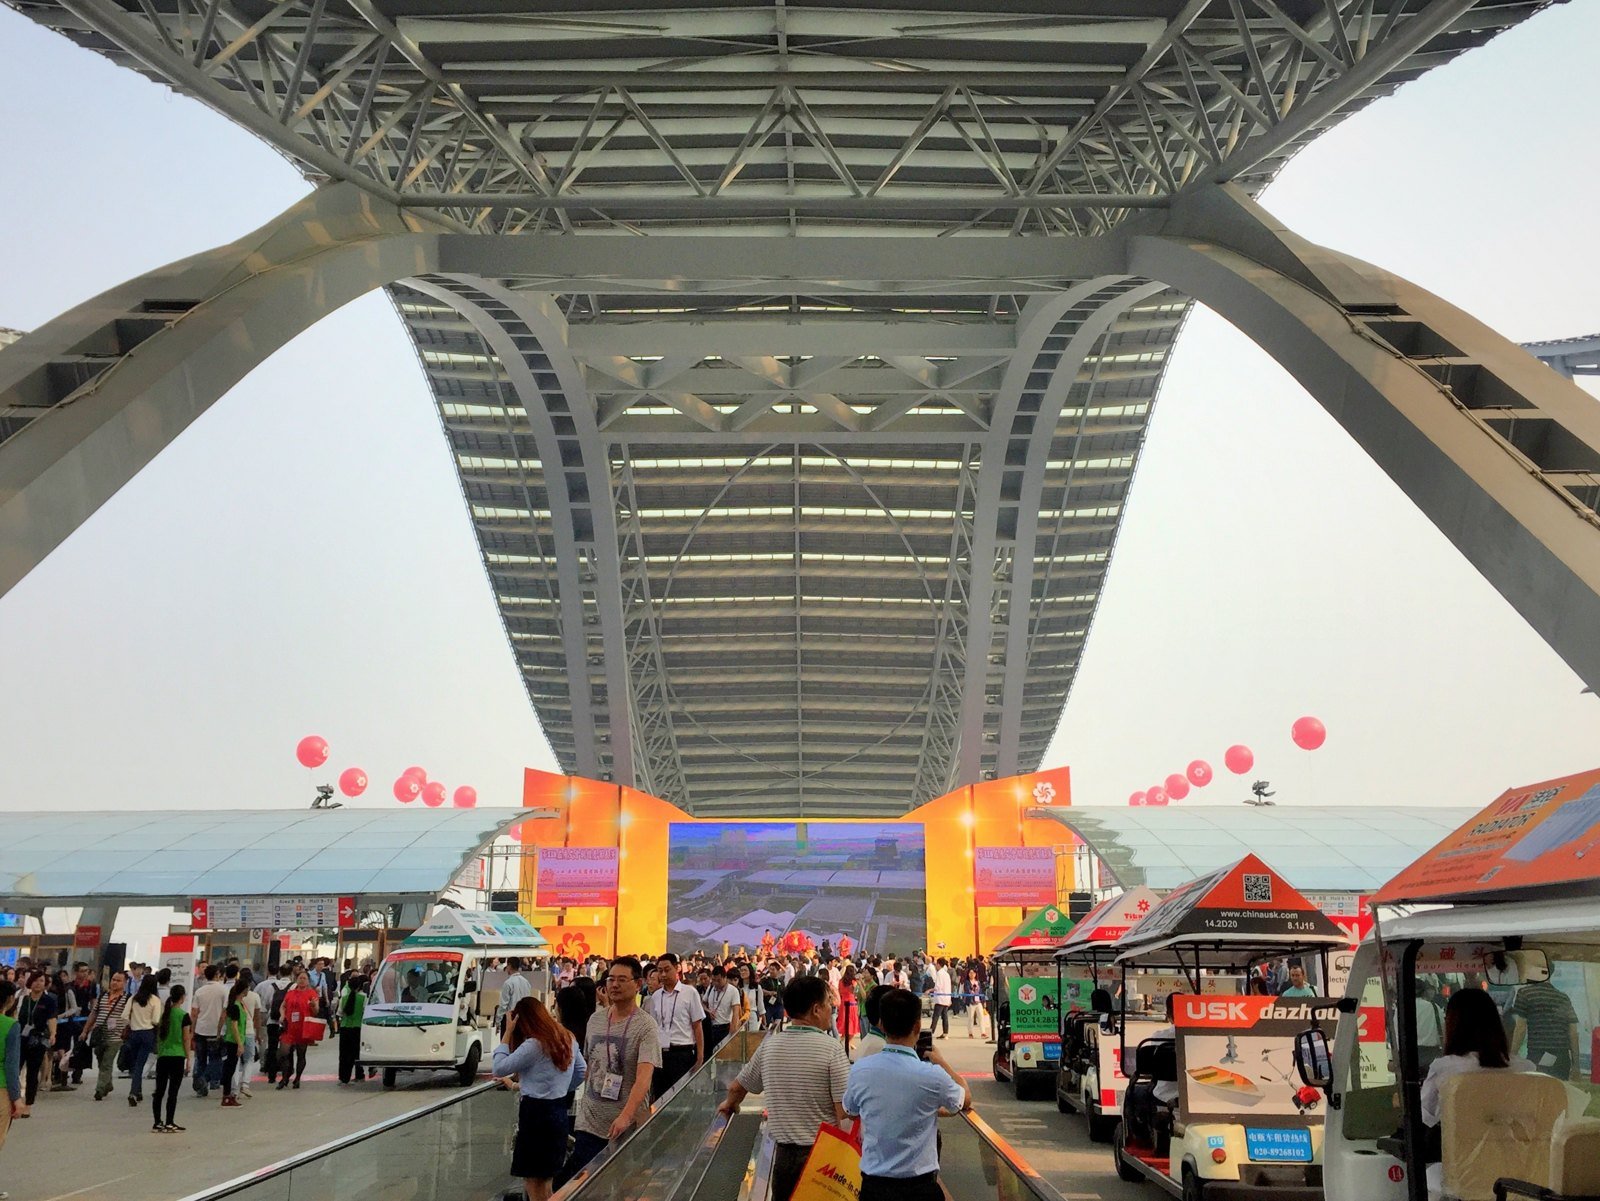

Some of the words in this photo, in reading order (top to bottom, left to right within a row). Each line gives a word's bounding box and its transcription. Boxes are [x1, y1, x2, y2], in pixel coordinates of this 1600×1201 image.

[1220, 910, 1298, 920] www.chinausk.com
[1204, 919, 1238, 929] 14.2D20
[1287, 921, 1315, 930] 8.1J15
[1016, 1008, 1042, 1016] BOOTH
[1186, 1001, 1249, 1020] USK
[1016, 1016, 1029, 1024] NO.
[1210, 1137, 1224, 1146] 09
[1254, 1147, 1305, 1158] 020-89268102
